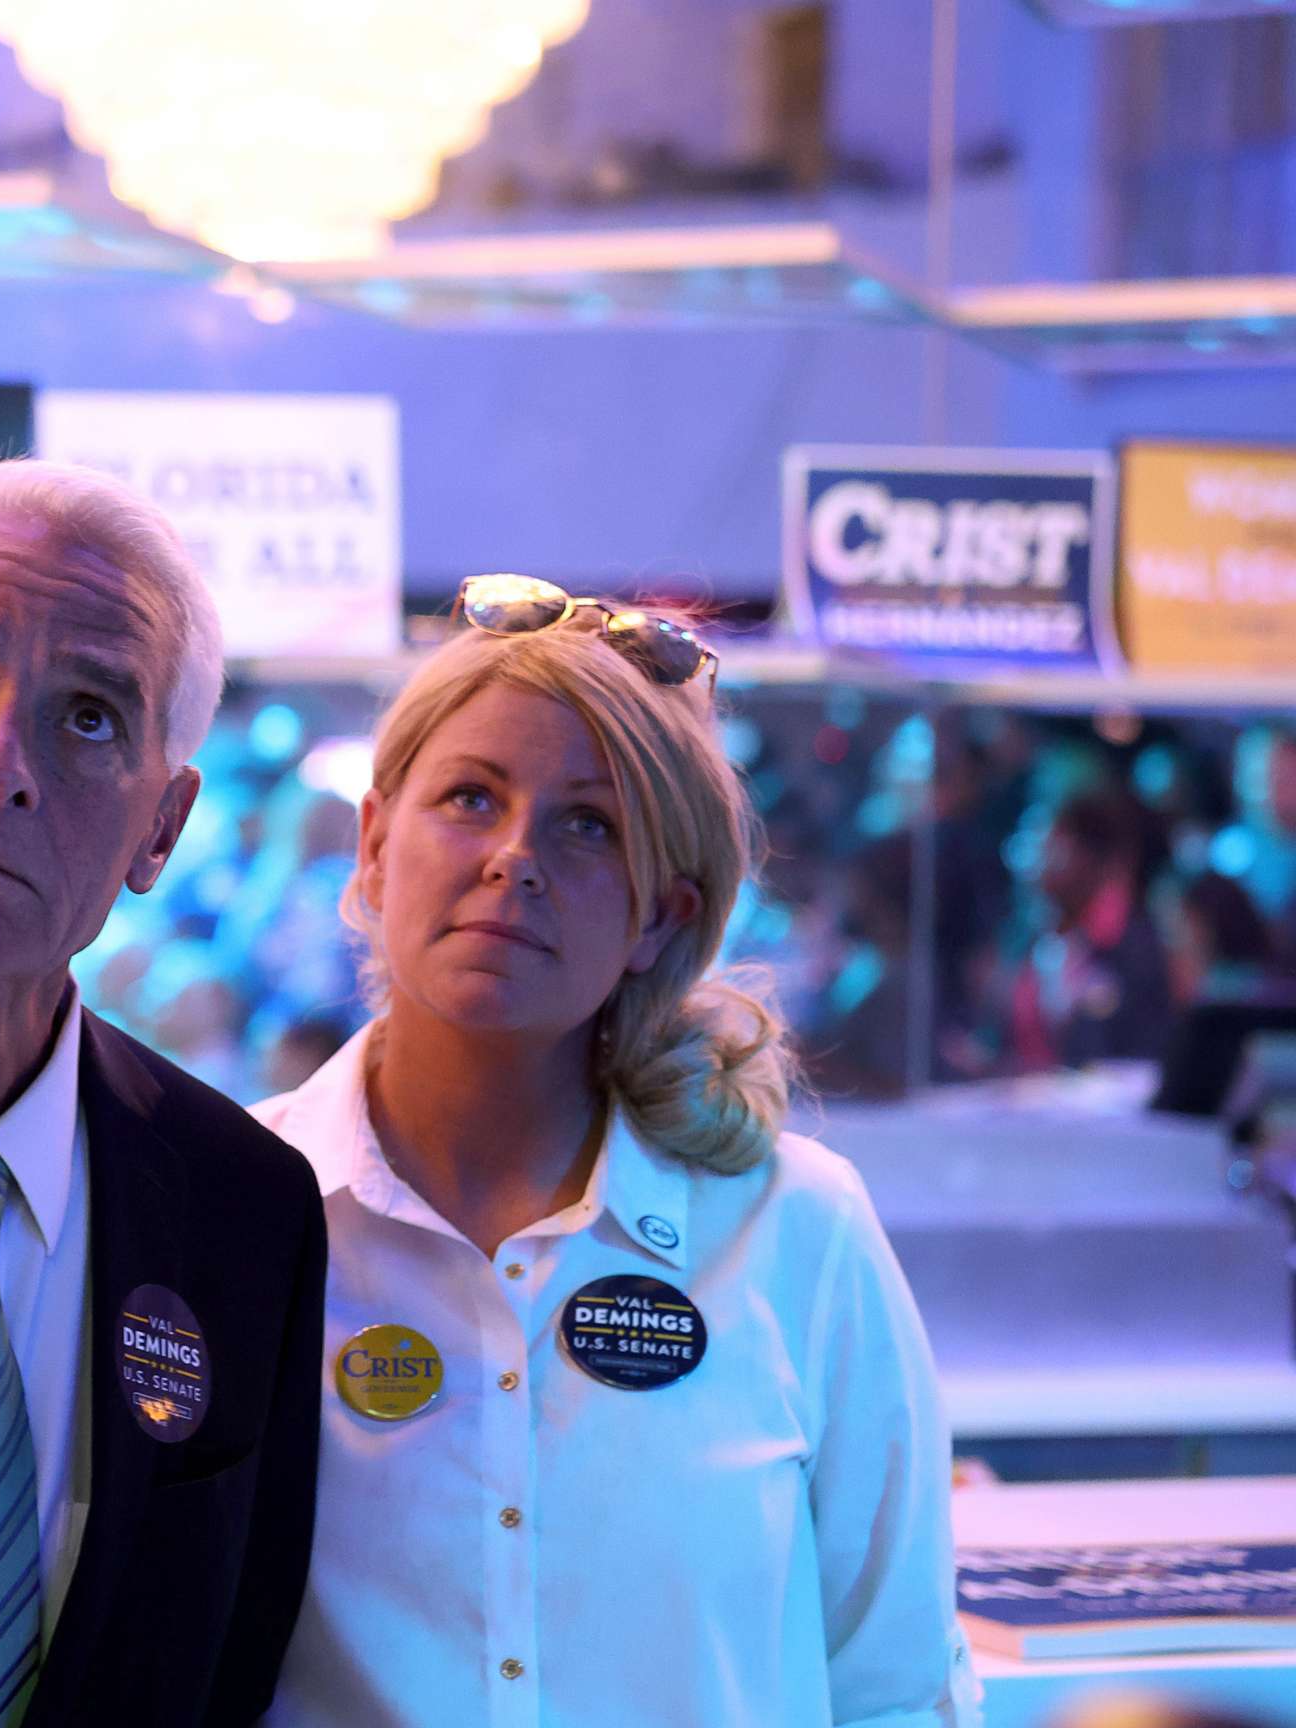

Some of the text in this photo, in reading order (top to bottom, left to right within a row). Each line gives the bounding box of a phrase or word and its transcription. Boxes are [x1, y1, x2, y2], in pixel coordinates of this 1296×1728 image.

[72, 454, 375, 513] ORIDA
[811, 480, 1088, 588] CRIST
[615, 1296, 653, 1310] VAL
[148, 1315, 174, 1335] VAL
[575, 1308, 693, 1333] DEMINGS
[123, 1326, 200, 1367] DEMINGS
[573, 1336, 693, 1359] U.S. SENATE
[342, 1350, 439, 1378] CRIST
[123, 1366, 201, 1401] U.S. SENATE
